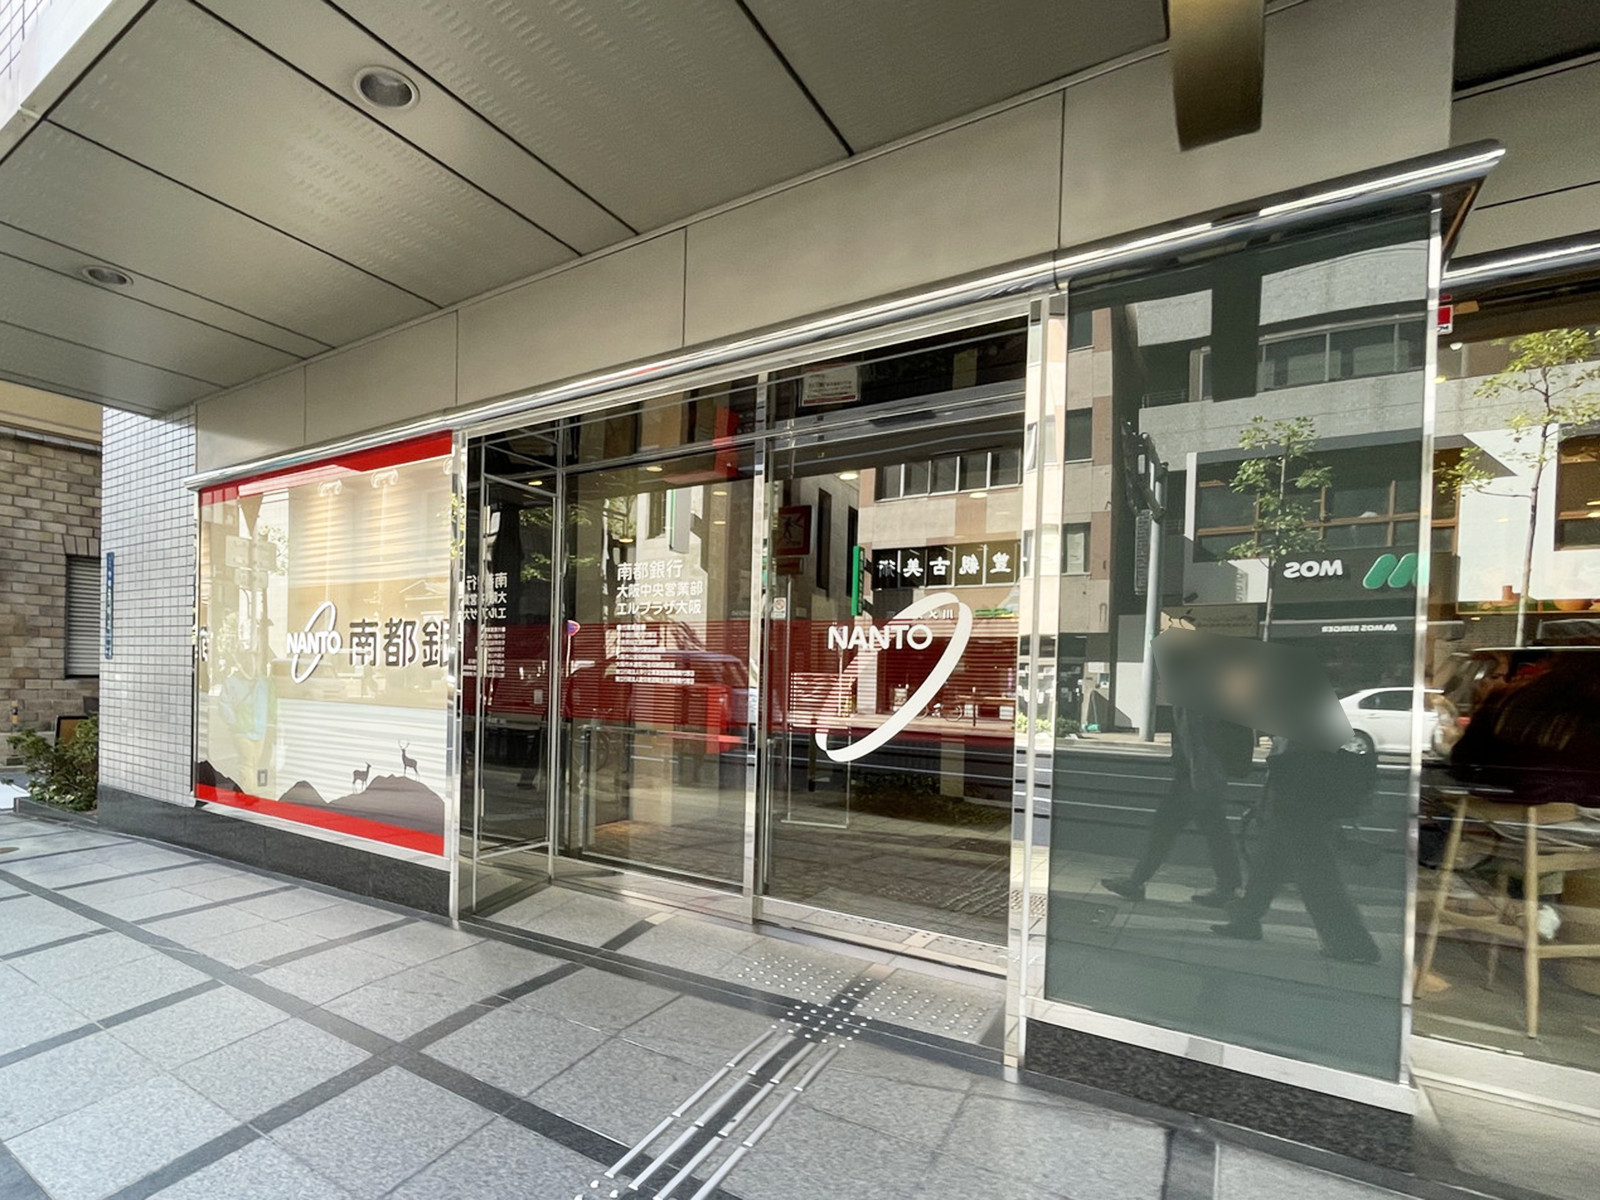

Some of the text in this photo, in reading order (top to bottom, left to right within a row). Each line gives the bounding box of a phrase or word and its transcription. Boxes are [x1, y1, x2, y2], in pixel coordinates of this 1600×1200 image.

[617, 559, 683, 582] 南都銀行
[616, 580, 704, 599] 大阪中央営業部
[287, 631, 342, 655] NANTO
[827, 624, 933, 650] NANTO
